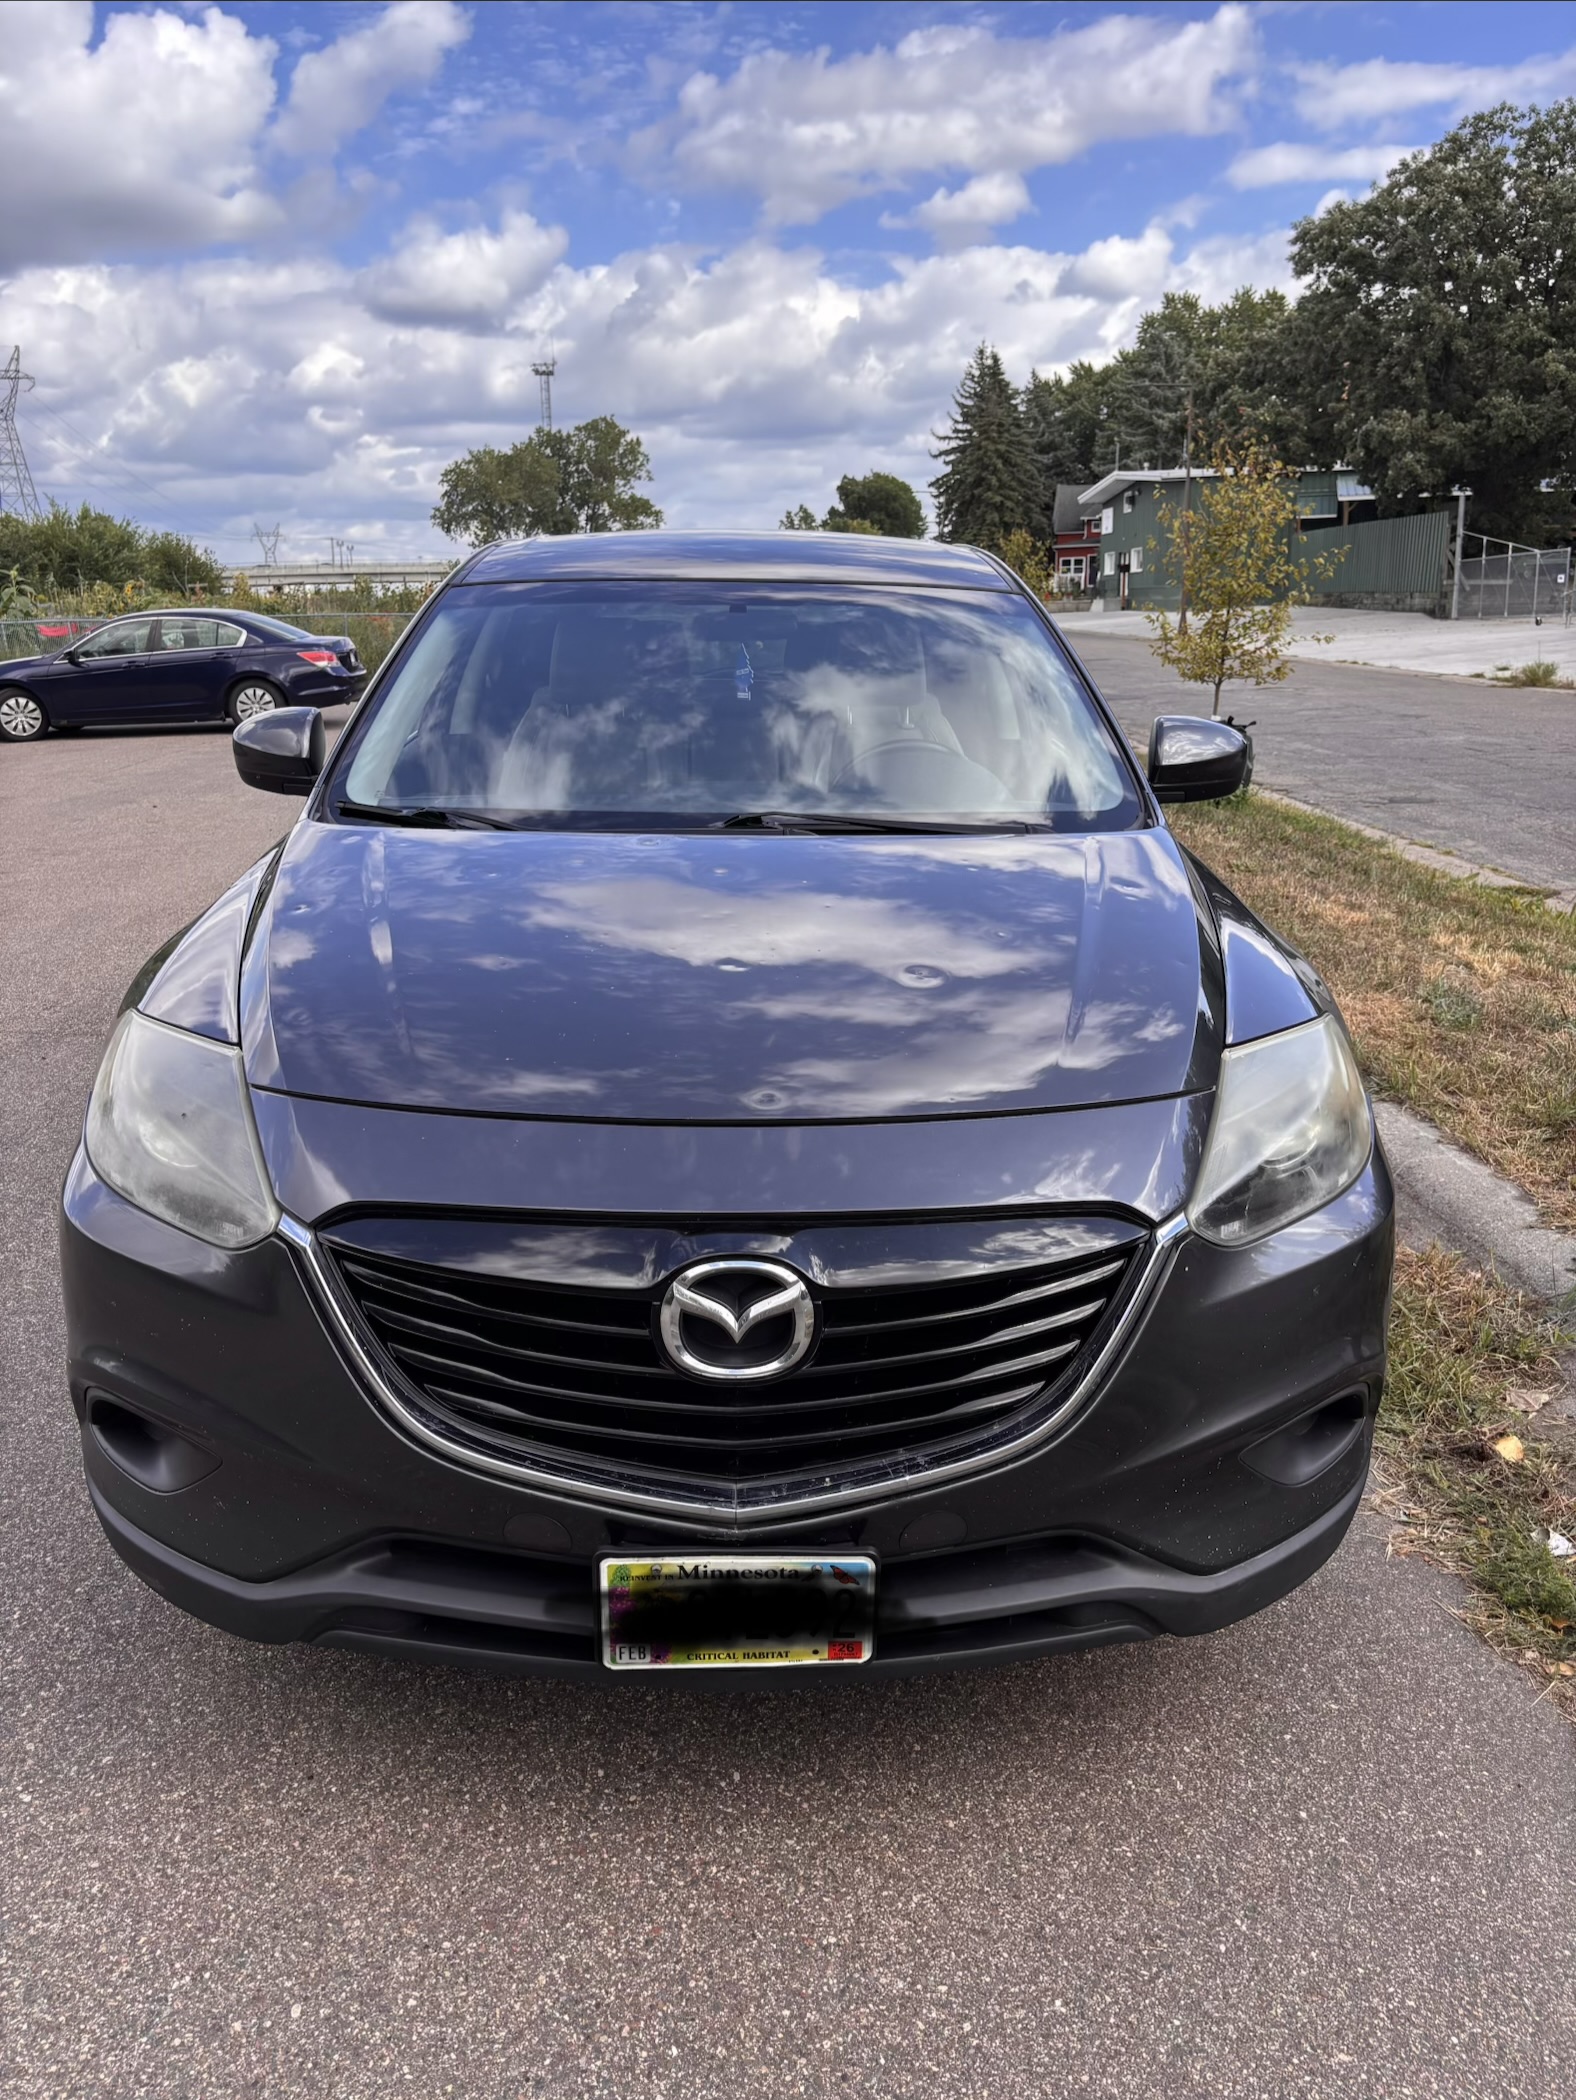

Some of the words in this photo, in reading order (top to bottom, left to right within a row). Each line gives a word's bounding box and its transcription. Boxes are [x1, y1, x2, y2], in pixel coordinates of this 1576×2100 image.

[677, 1565, 799, 1580] Minnesota
[618, 1645, 647, 1661] FEB
[837, 1643, 855, 1653] 26
[686, 1651, 738, 1661] CRITICAL
[742, 1650, 791, 1660] HABITAT
